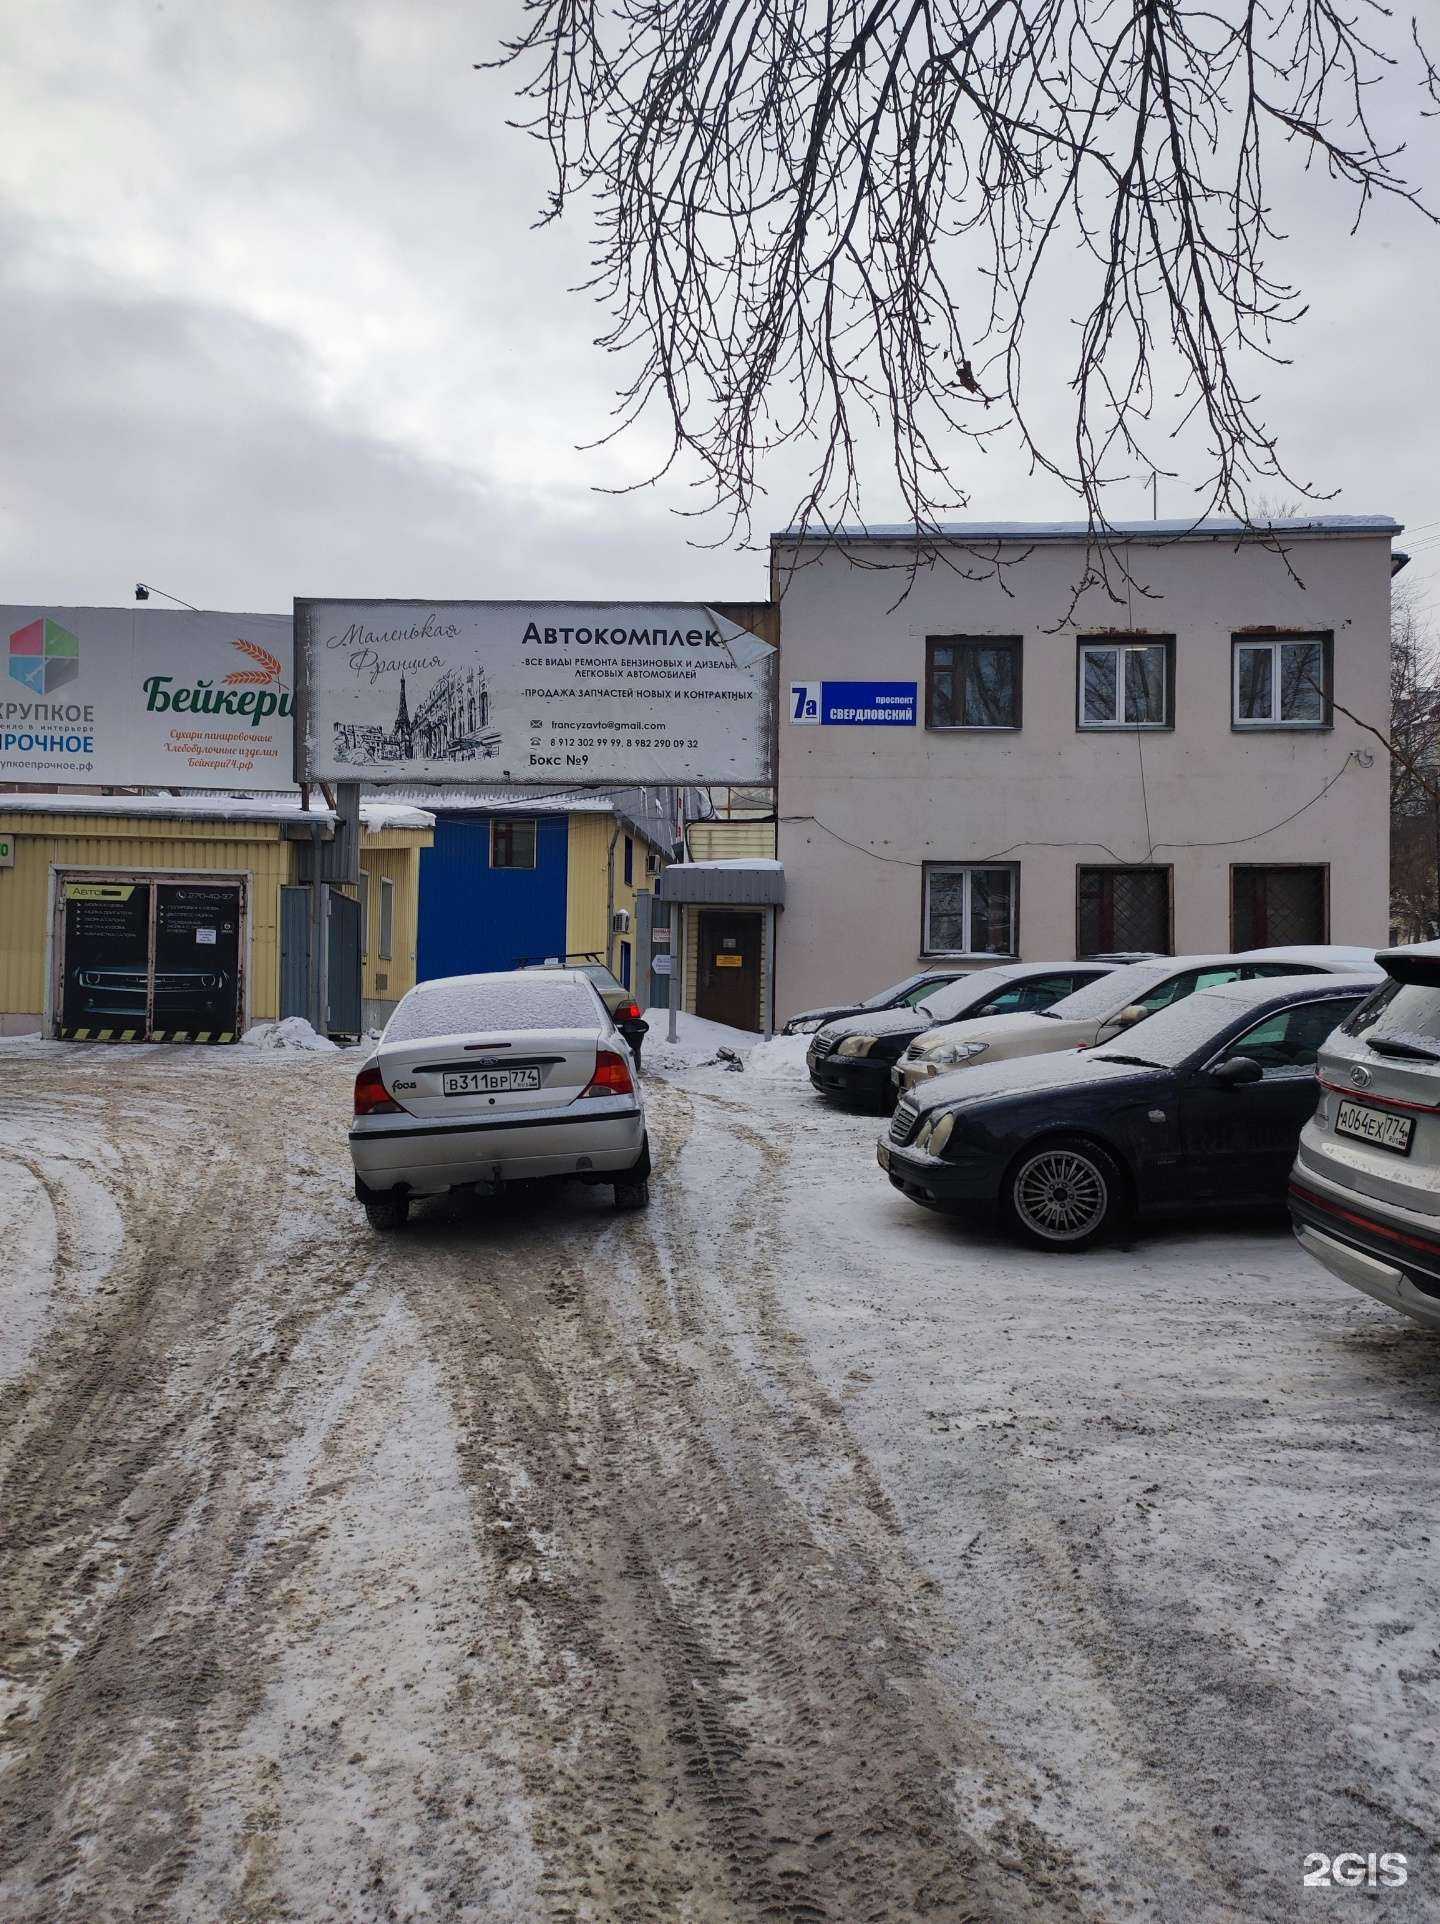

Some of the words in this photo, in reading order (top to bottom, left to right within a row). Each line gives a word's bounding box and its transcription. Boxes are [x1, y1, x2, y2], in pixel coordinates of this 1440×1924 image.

[326, 614, 462, 649] Маленькая
[349, 648, 446, 685] Франция
[545, 658, 572, 668] ВИДЫ
[574, 658, 618, 667] РЕМОНТА
[621, 659, 683, 668] БЕНЗИНОВЫХ
[685, 660, 692, 668] И
[574, 669, 624, 679] ЛЕГКОВЫХ
[626, 669, 697, 680] АВТОМОБИЛЕЙ
[578, 688, 633, 699] ЗАПЧАСТЕЙ
[636, 690, 671, 699] НОВЫХ
[674, 690, 681, 699] И
[683, 690, 753, 701] КОНТРАКТНЫХ
[875, 696, 914, 705] проспект
[142, 676, 294, 727] Бейкери
[829, 707, 913, 721] СВЕРДЛОВСКИЙ
[551, 720, 666, 731] francyzavto@gmail.com
[0, 733, 94, 753] РОЧНОЕ
[550, 738, 556, 747] 8
[558, 738, 575, 747] 912
[577, 739, 594, 747] 302
[597, 739, 608, 747] 99
[626, 739, 632, 748] 8
[634, 740, 651, 748] 982
[654, 740, 671, 748] 290
[673, 740, 685, 748] 09
[687, 740, 699, 748] 32
[529, 754, 561, 766] Бокс
[566, 754, 589, 766] №9
[449, 1074, 508, 1091] В311ВР
[511, 1071, 537, 1083] 774
[1341, 1108, 1384, 1139] А064ЕХ
[1386, 1117, 1407, 1138] 774
